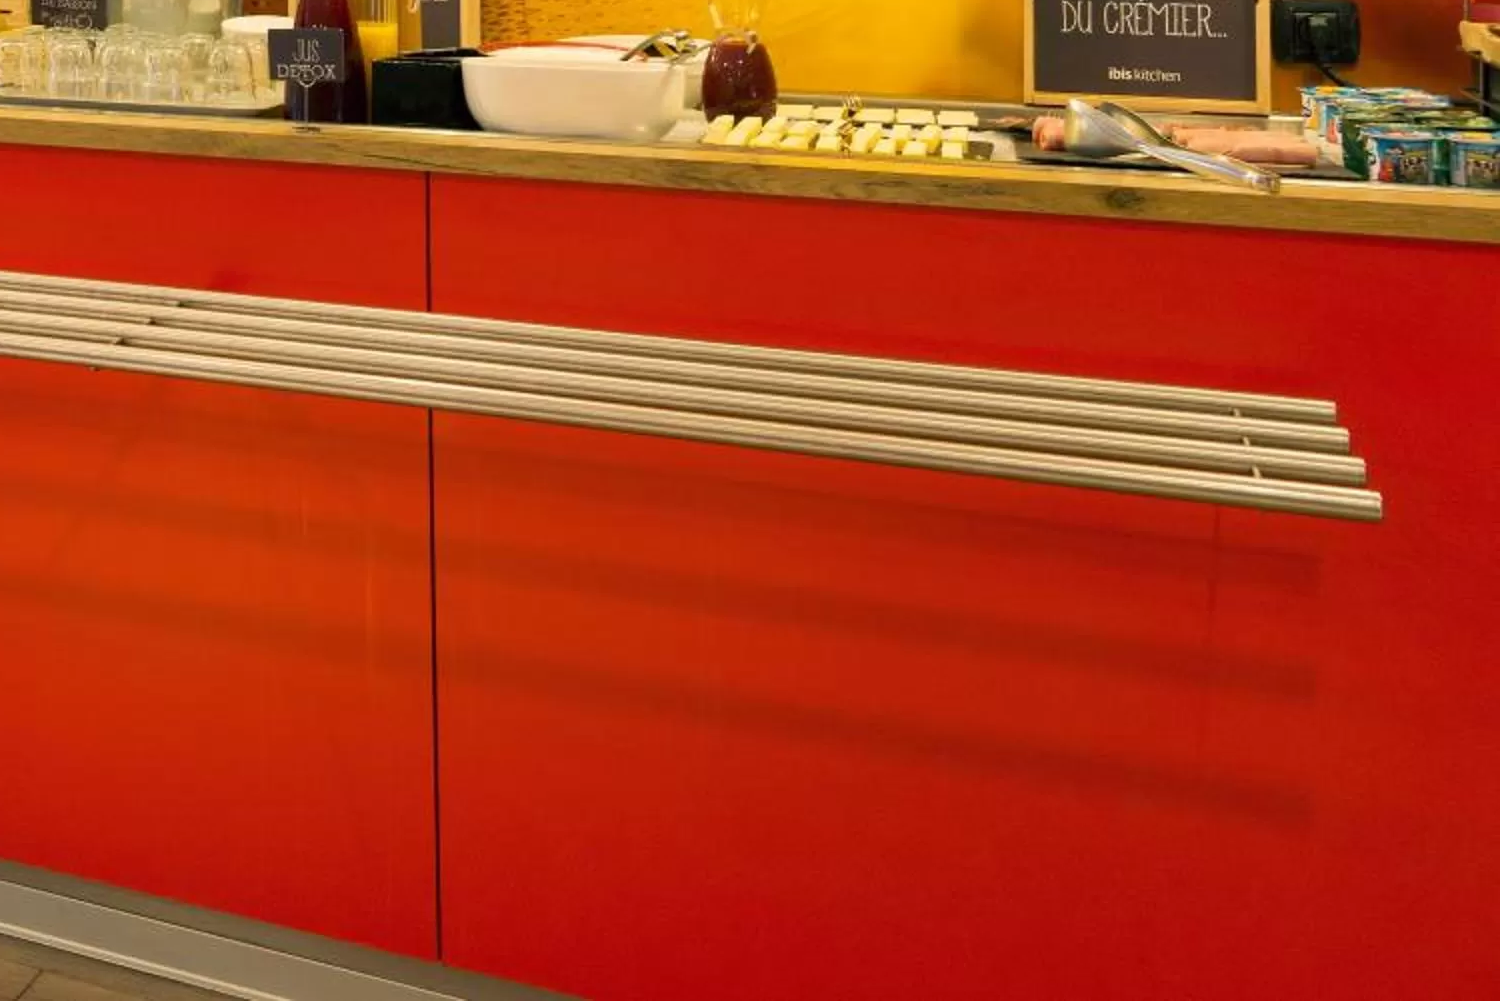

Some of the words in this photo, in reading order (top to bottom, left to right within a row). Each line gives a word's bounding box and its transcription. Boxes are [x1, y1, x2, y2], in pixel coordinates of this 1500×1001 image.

[1061, 0, 1093, 34] DU
[292, 38, 321, 63] JUS
[276, 63, 337, 80] DETOX
[1107, 66, 1133, 81] ibis
[1134, 67, 1182, 82] kitchen
